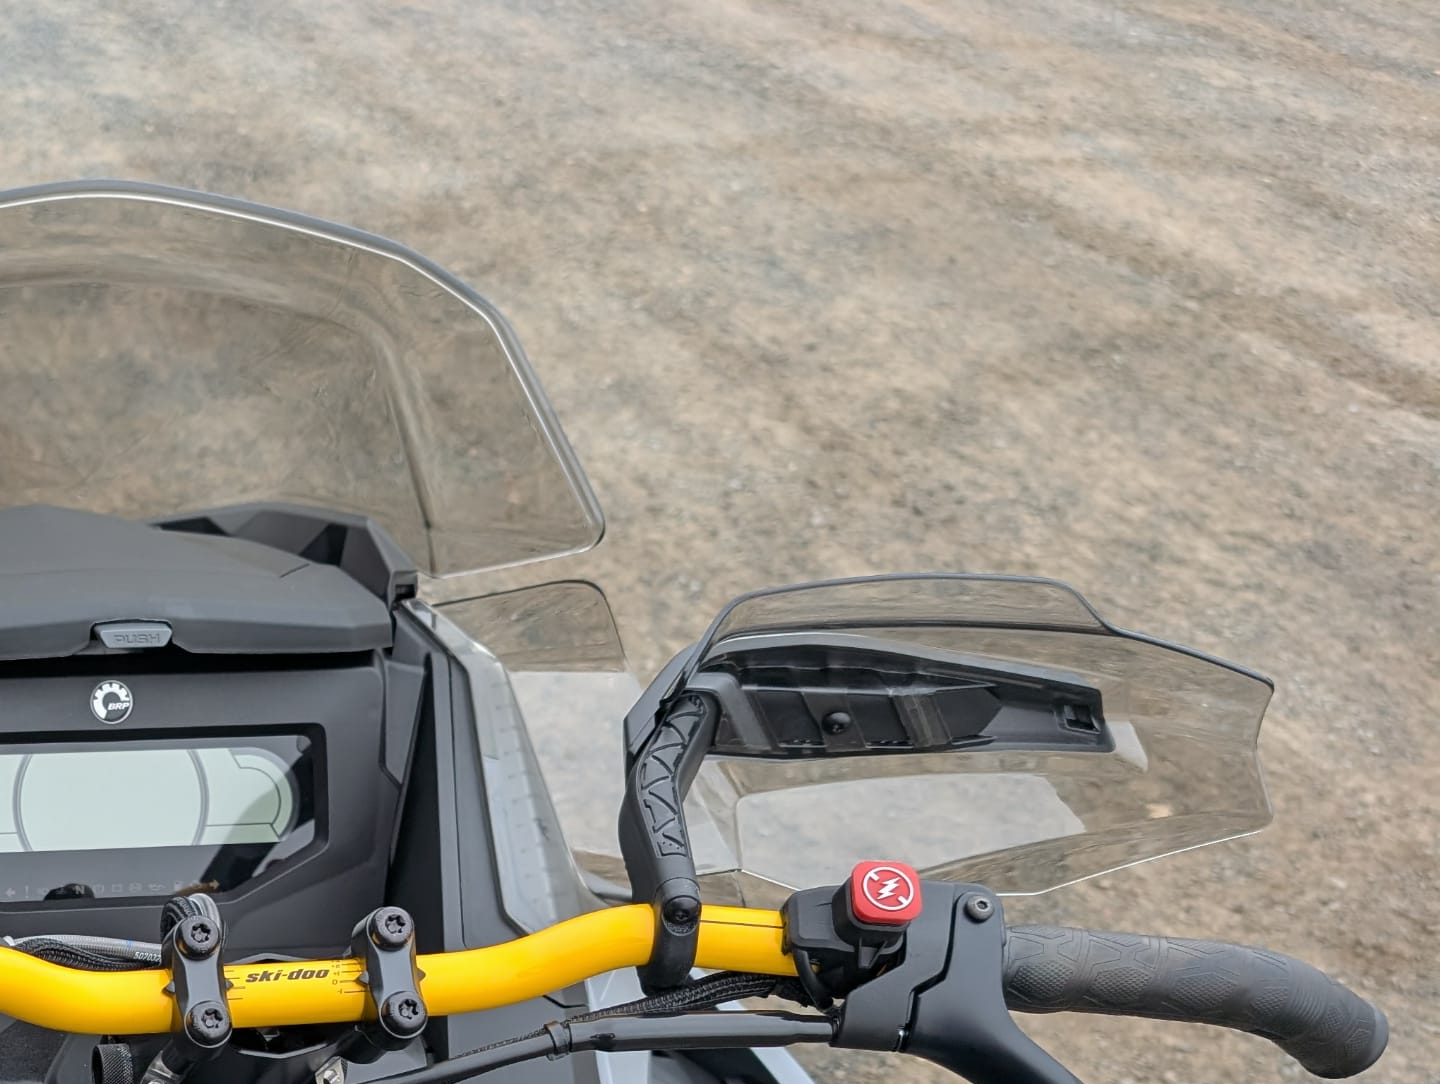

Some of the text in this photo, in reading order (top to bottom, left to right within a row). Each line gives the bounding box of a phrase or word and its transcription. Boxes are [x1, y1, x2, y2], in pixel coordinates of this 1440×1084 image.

[112, 633, 161, 644] PUSH
[107, 702, 130, 711] BRP
[75, 885, 85, 895] N
[245, 968, 330, 983] ski-doo
